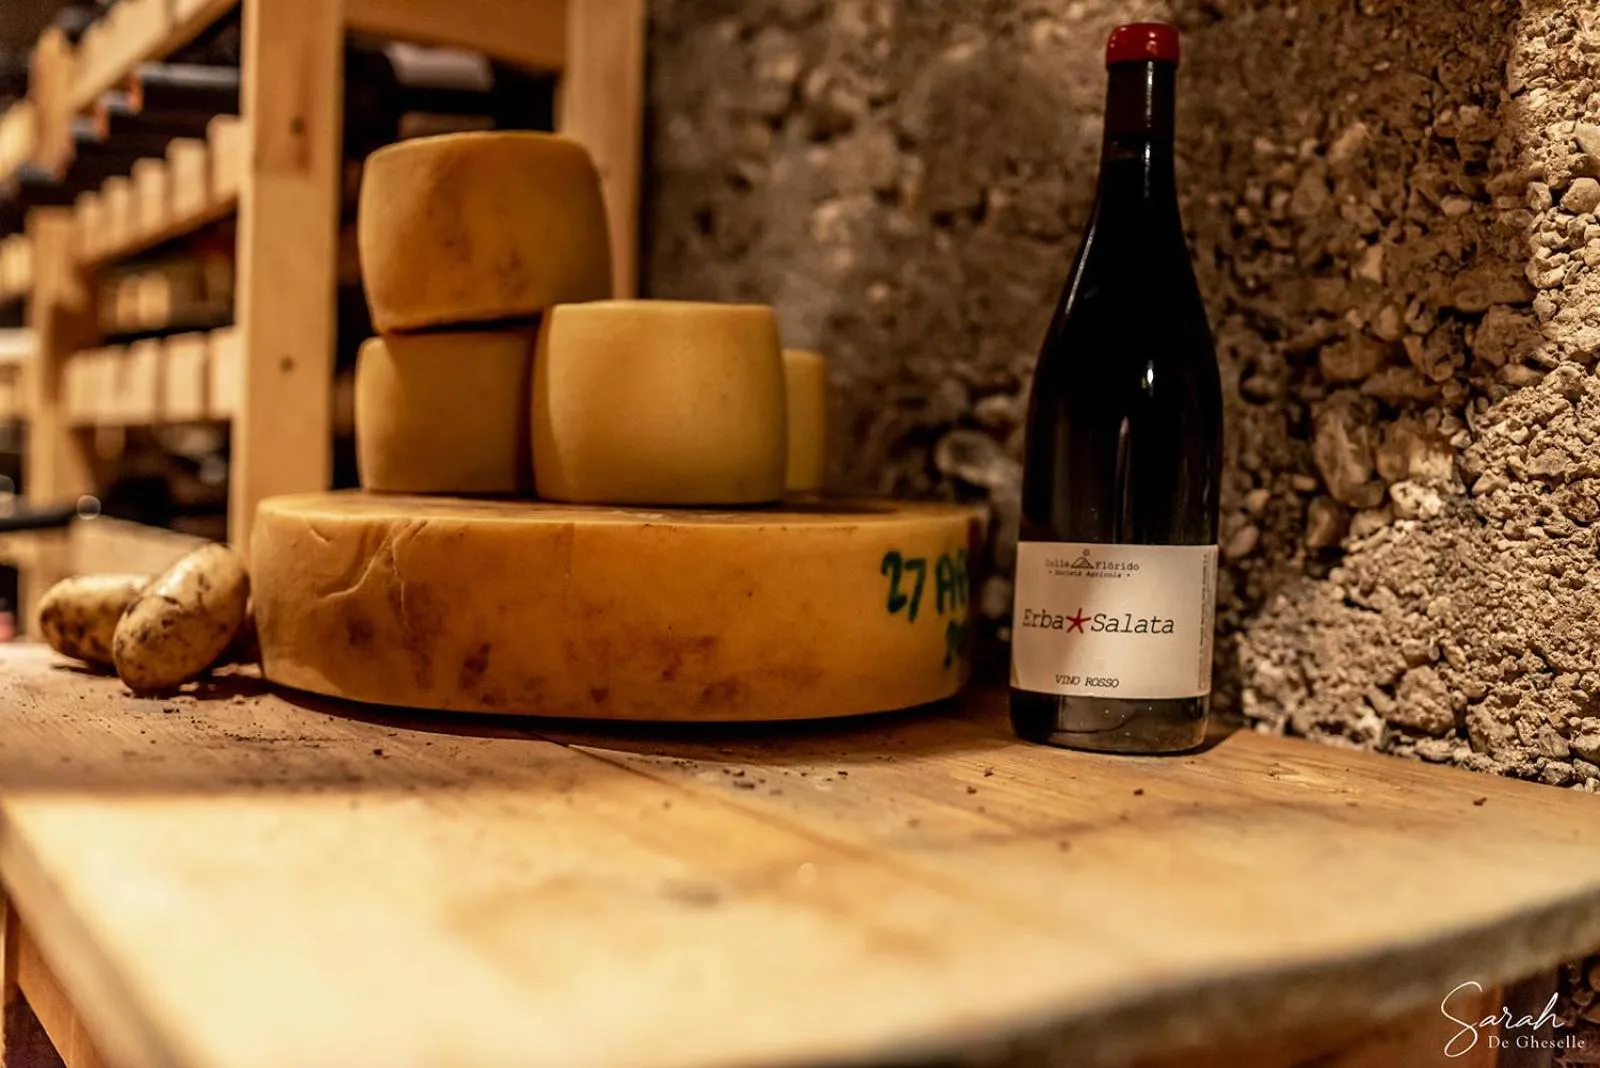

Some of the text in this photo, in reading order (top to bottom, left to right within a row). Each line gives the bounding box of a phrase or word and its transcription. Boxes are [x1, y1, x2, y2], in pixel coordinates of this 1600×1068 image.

[881, 551, 926, 623] 27
[1023, 609, 1175, 634] Erba Salata
[1055, 675, 1119, 688] VINO ROSSO
